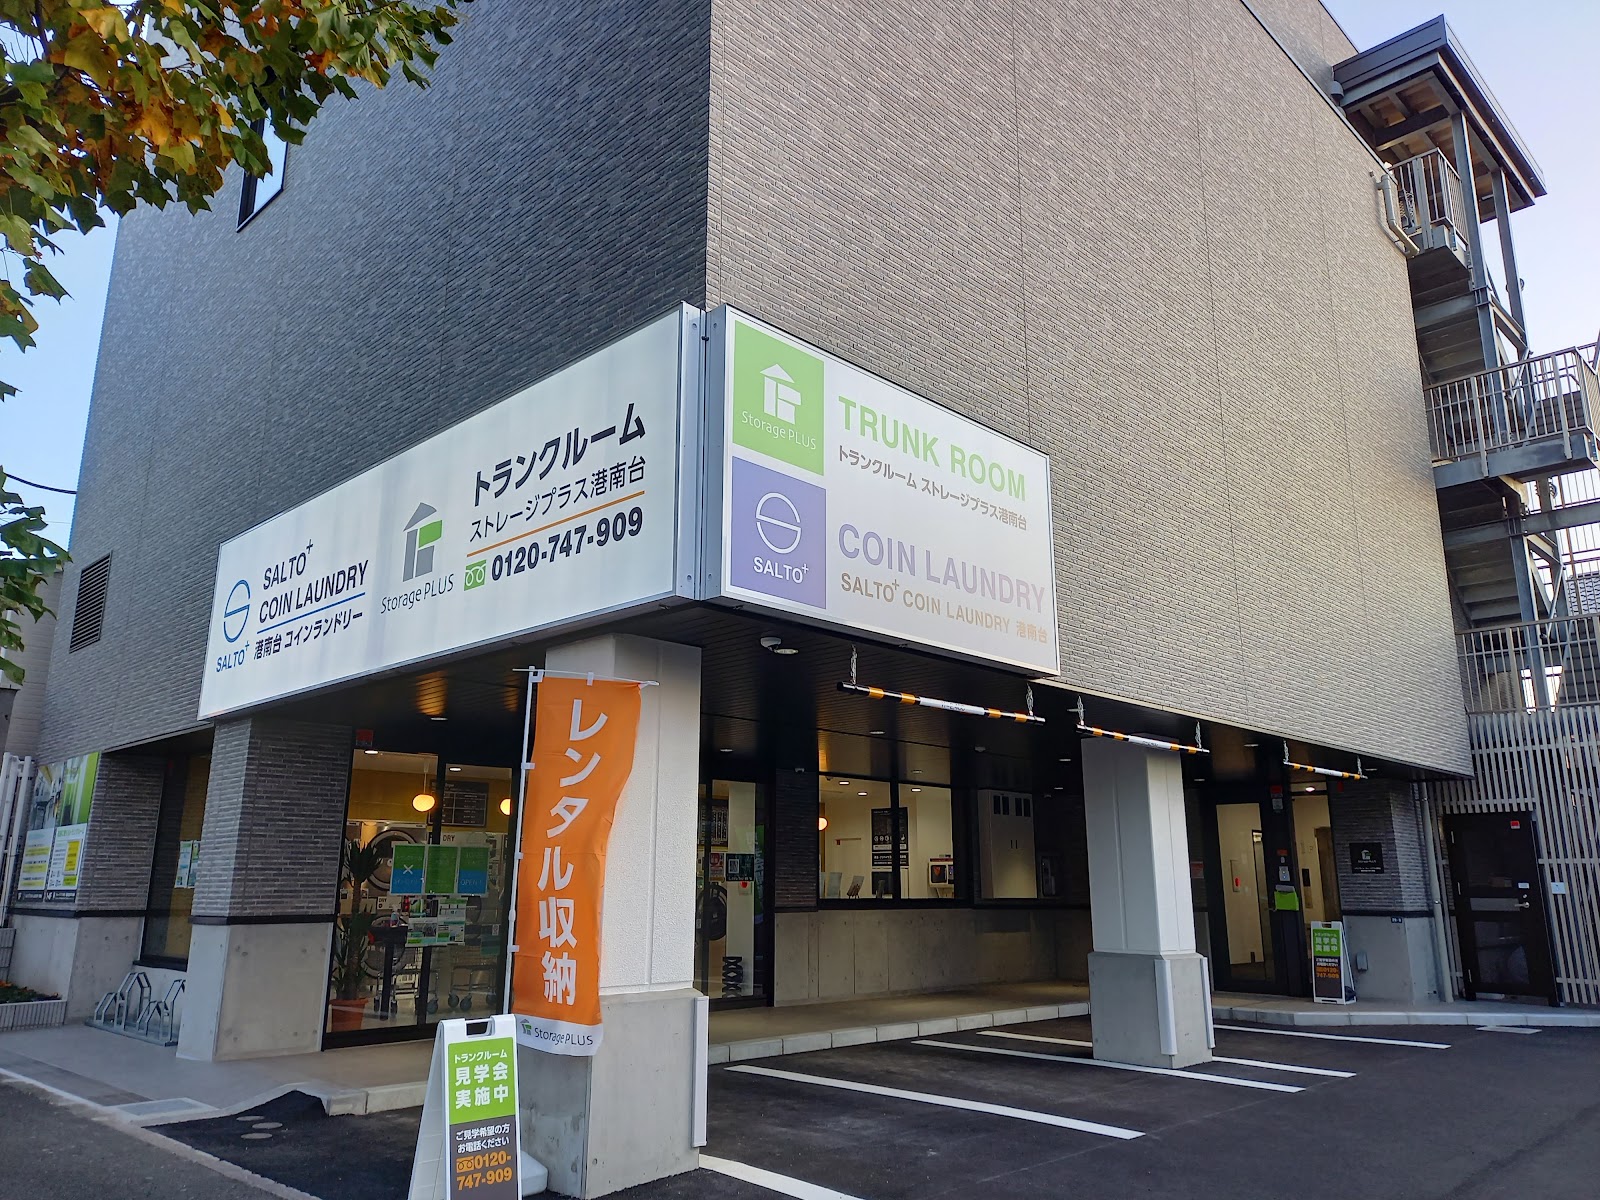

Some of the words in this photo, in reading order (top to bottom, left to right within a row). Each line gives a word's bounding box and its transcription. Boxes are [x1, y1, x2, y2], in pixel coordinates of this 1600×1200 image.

[474, 403, 646, 507] トランクルーム
[741, 410, 786, 439] Storage
[788, 428, 817, 450] PLUS
[838, 395, 940, 468] TRUNK
[950, 443, 1026, 502] ROOM
[470, 455, 646, 542] ストレージプラス港南台
[839, 444, 917, 490] トランクルーム
[921, 477, 1027, 531] ストレージプラス港南台
[491, 506, 643, 581] 0120-747-909
[838, 523, 916, 577] COIN
[925, 549, 1045, 614] LAUNDRY
[259, 590, 293, 624] COIN
[295, 559, 369, 611] LAUNDRY
[380, 587, 422, 614] Storage
[423, 573, 455, 600] PLUS
[903, 589, 941, 616] COIN
[946, 601, 1010, 634] LAUNDRY
[1016, 620, 1049, 644] 港南台
[254, 633, 282, 661] 港南台
[284, 608, 363, 647] コインランドリー
[537, 698, 608, 1006] レンタル収納
[454, 1049, 508, 1064] トランクルーム
[455, 1061, 509, 1087] 見学会
[455, 1084, 509, 1110] 実施中
[455, 1123, 511, 1141] ご見学希望の方
[457, 1137, 510, 1154] お電話ください
[456, 1167, 513, 1191] 747-909
[474, 1150, 512, 1170] 0120-
